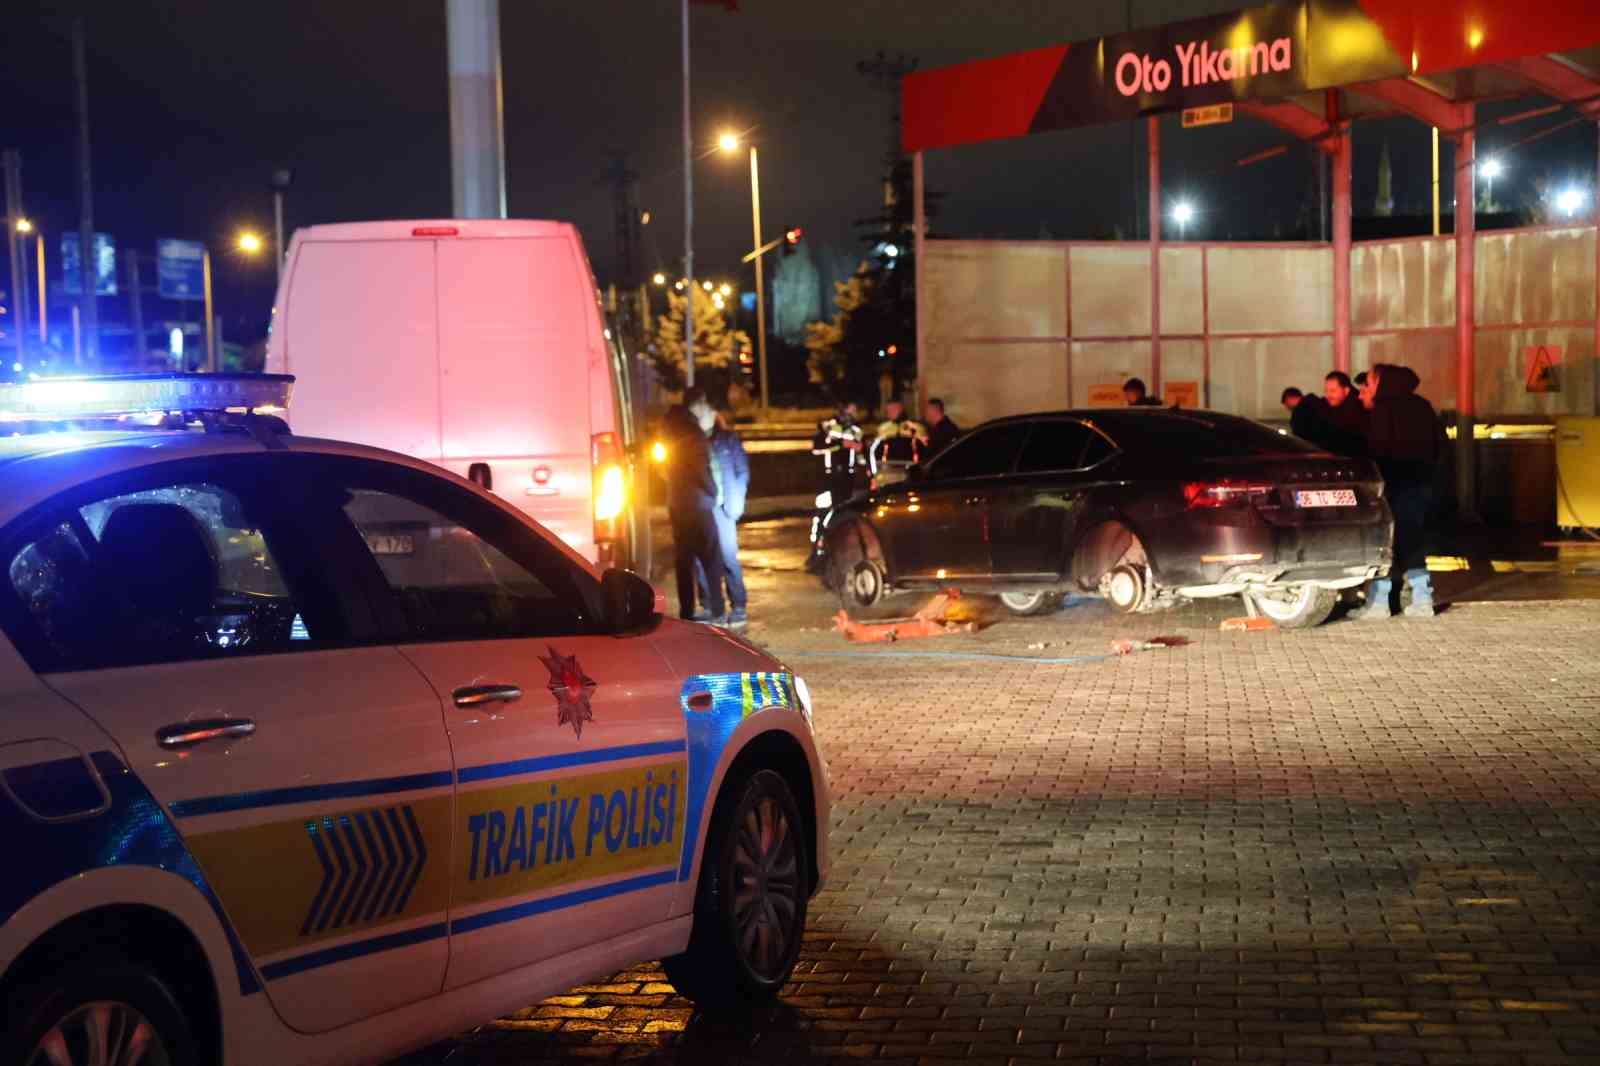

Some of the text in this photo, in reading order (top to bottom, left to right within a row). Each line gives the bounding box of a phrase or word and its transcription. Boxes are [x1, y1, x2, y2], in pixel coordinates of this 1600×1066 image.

[1115, 37, 1292, 96] Oto Yıkama
[468, 769, 679, 881] TRAFİK POLİSİ
